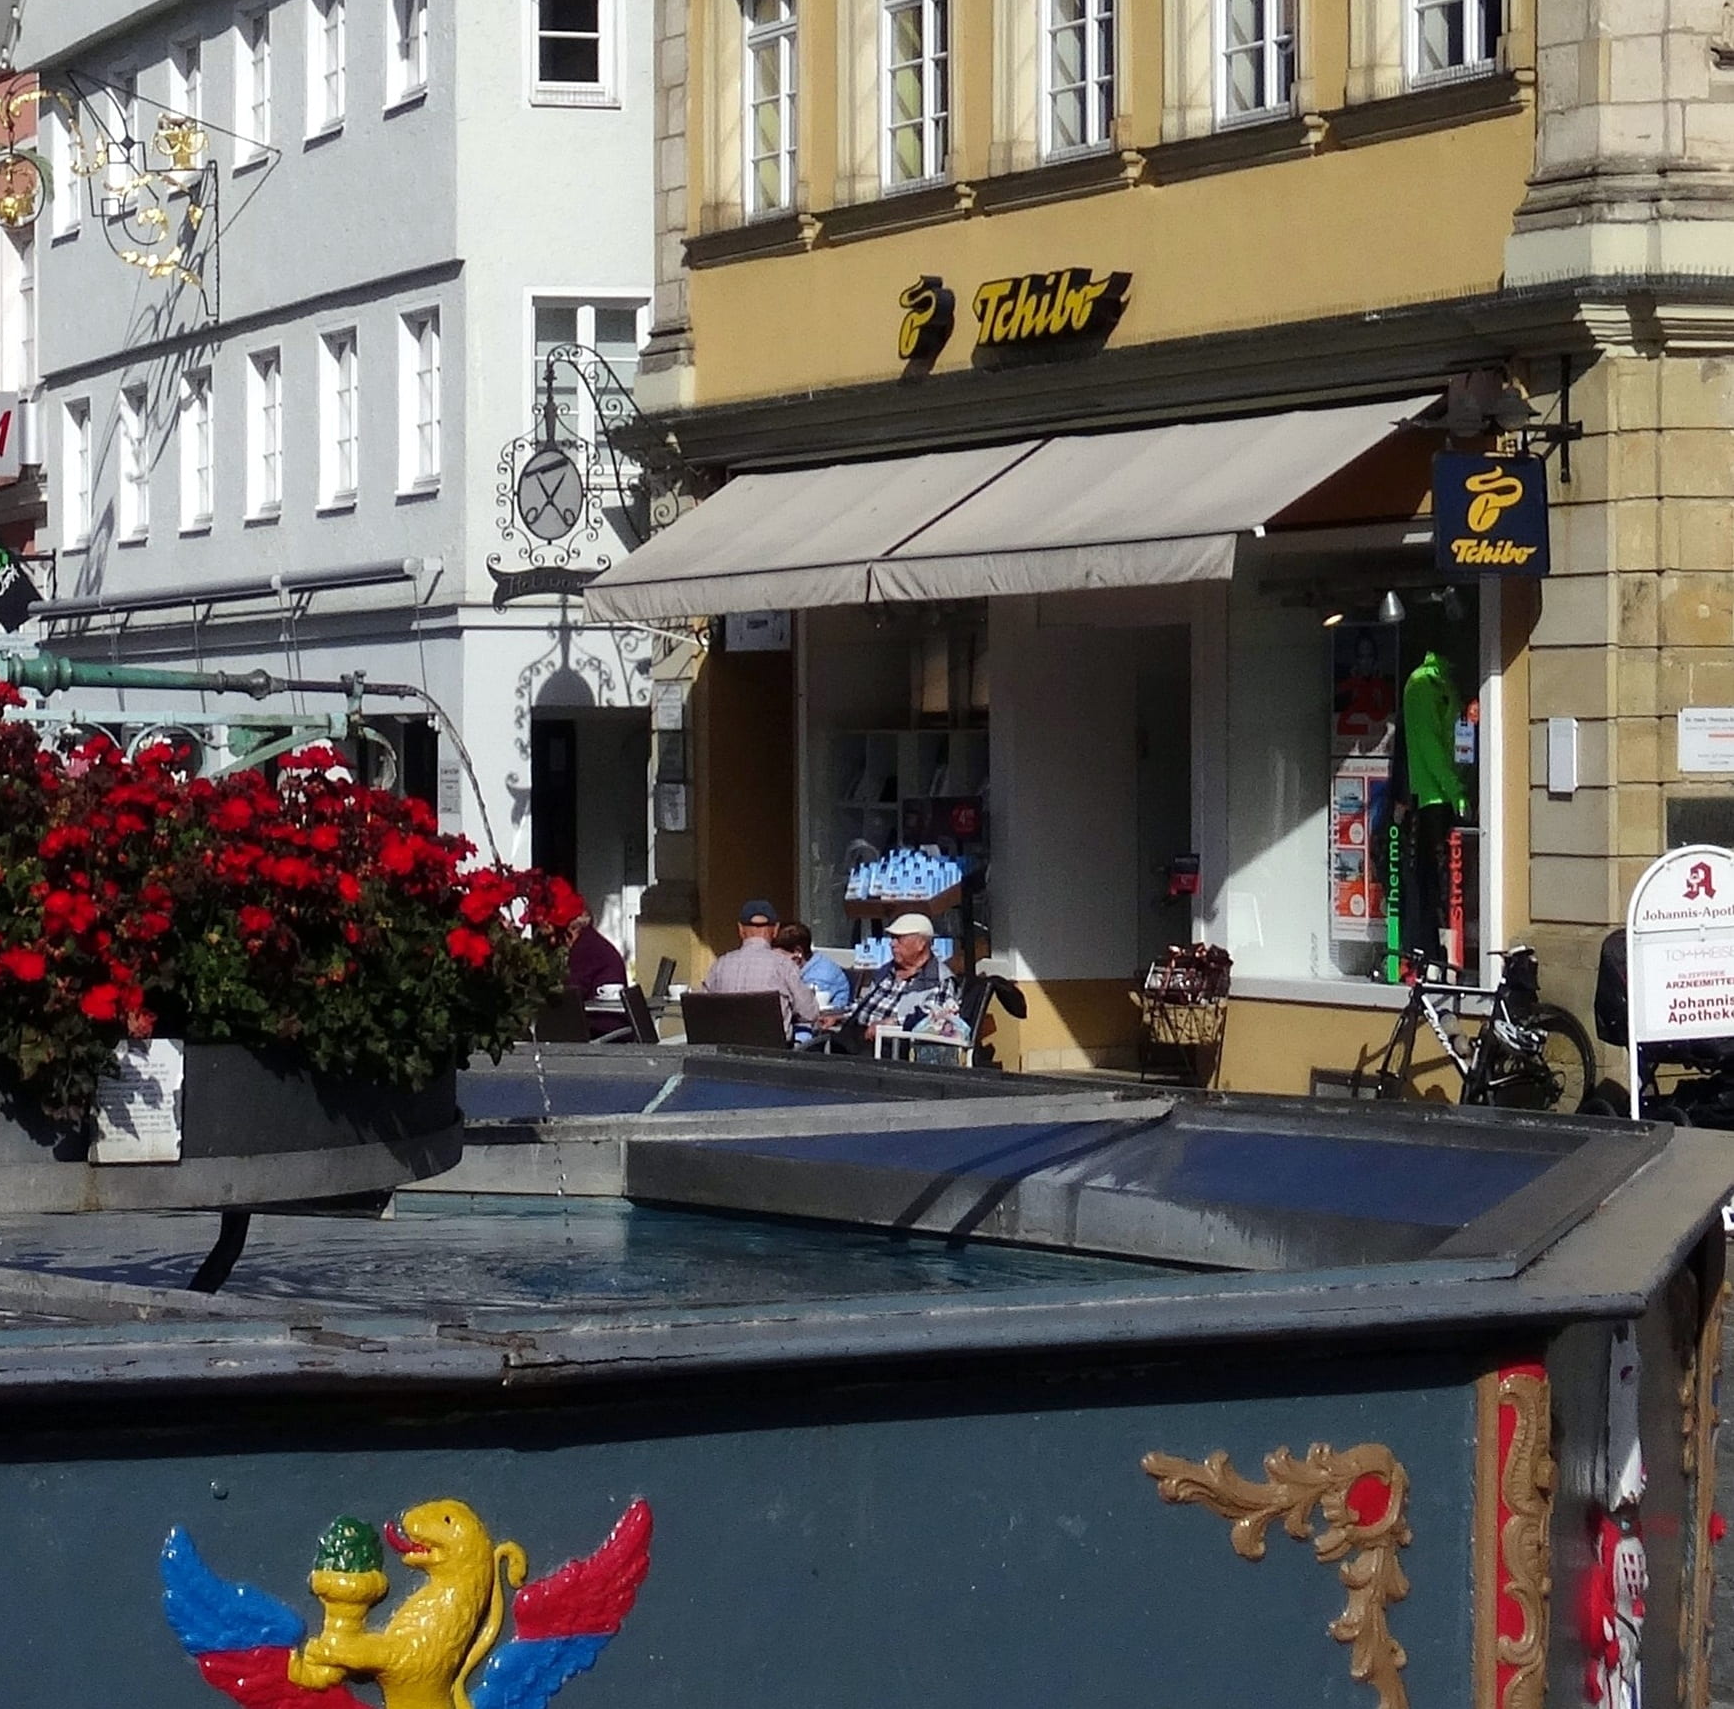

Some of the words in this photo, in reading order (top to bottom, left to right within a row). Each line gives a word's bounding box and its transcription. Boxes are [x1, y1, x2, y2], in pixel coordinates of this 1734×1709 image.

[973, 269, 1109, 344] Tchibo
[1451, 539, 1537, 564] Tchibo
[1387, 825, 1400, 917] Thermo
[1446, 831, 1463, 921] Stretch
